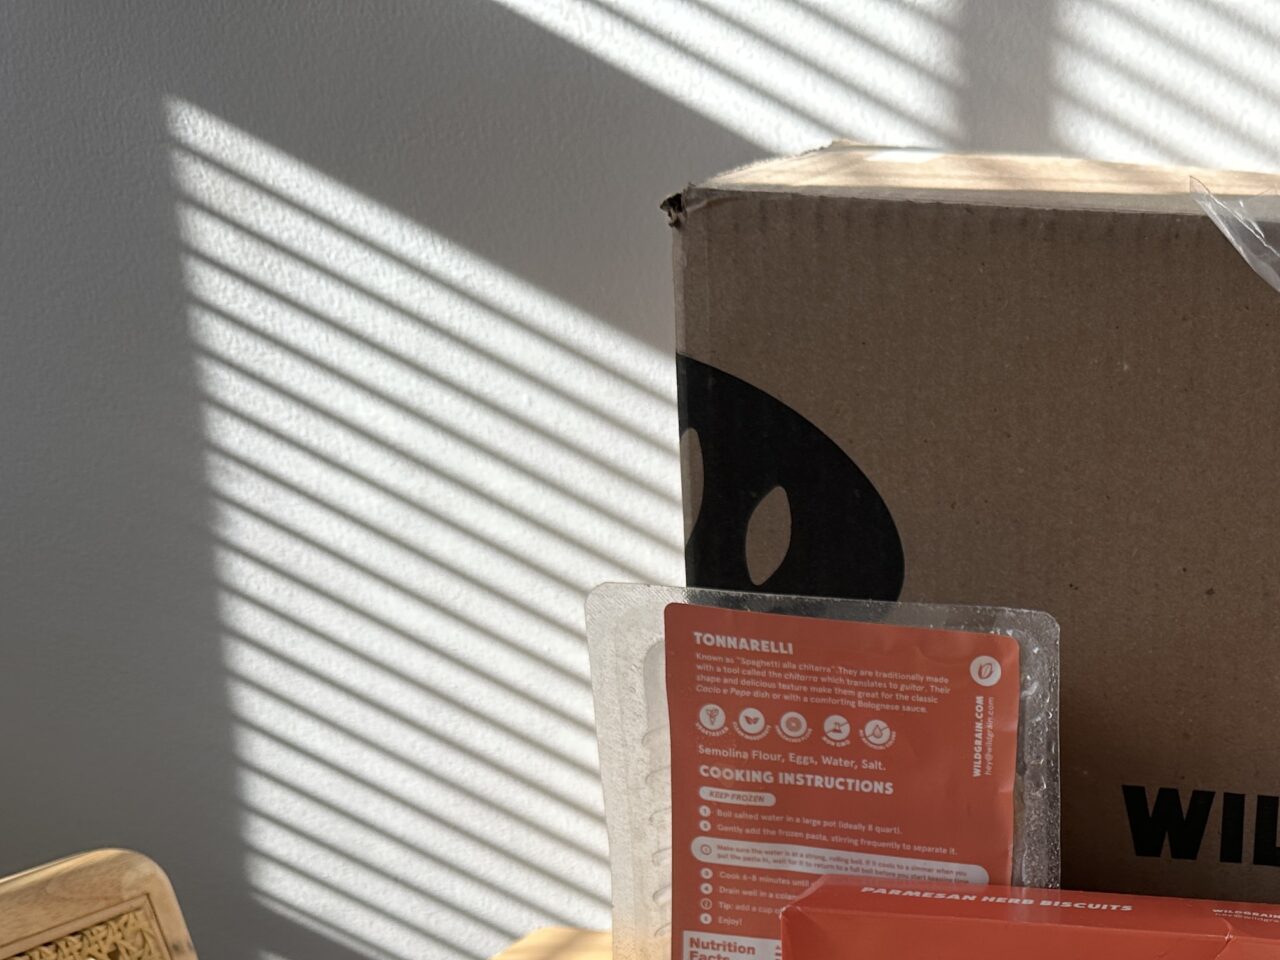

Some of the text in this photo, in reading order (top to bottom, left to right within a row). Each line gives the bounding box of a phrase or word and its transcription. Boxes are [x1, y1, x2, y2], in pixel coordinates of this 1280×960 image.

[693, 632, 794, 655] TONNARELLI
[973, 695, 984, 777] WILDGRAIN.COM
[698, 744, 887, 771] Semolina Flour, Eggs, Water, Salt.
[699, 764, 894, 795] COOKING INSTRUCTIONS
[861, 886, 1132, 911] PARMESAN HERB BISCUITS
[688, 937, 756, 956] Nutrition
